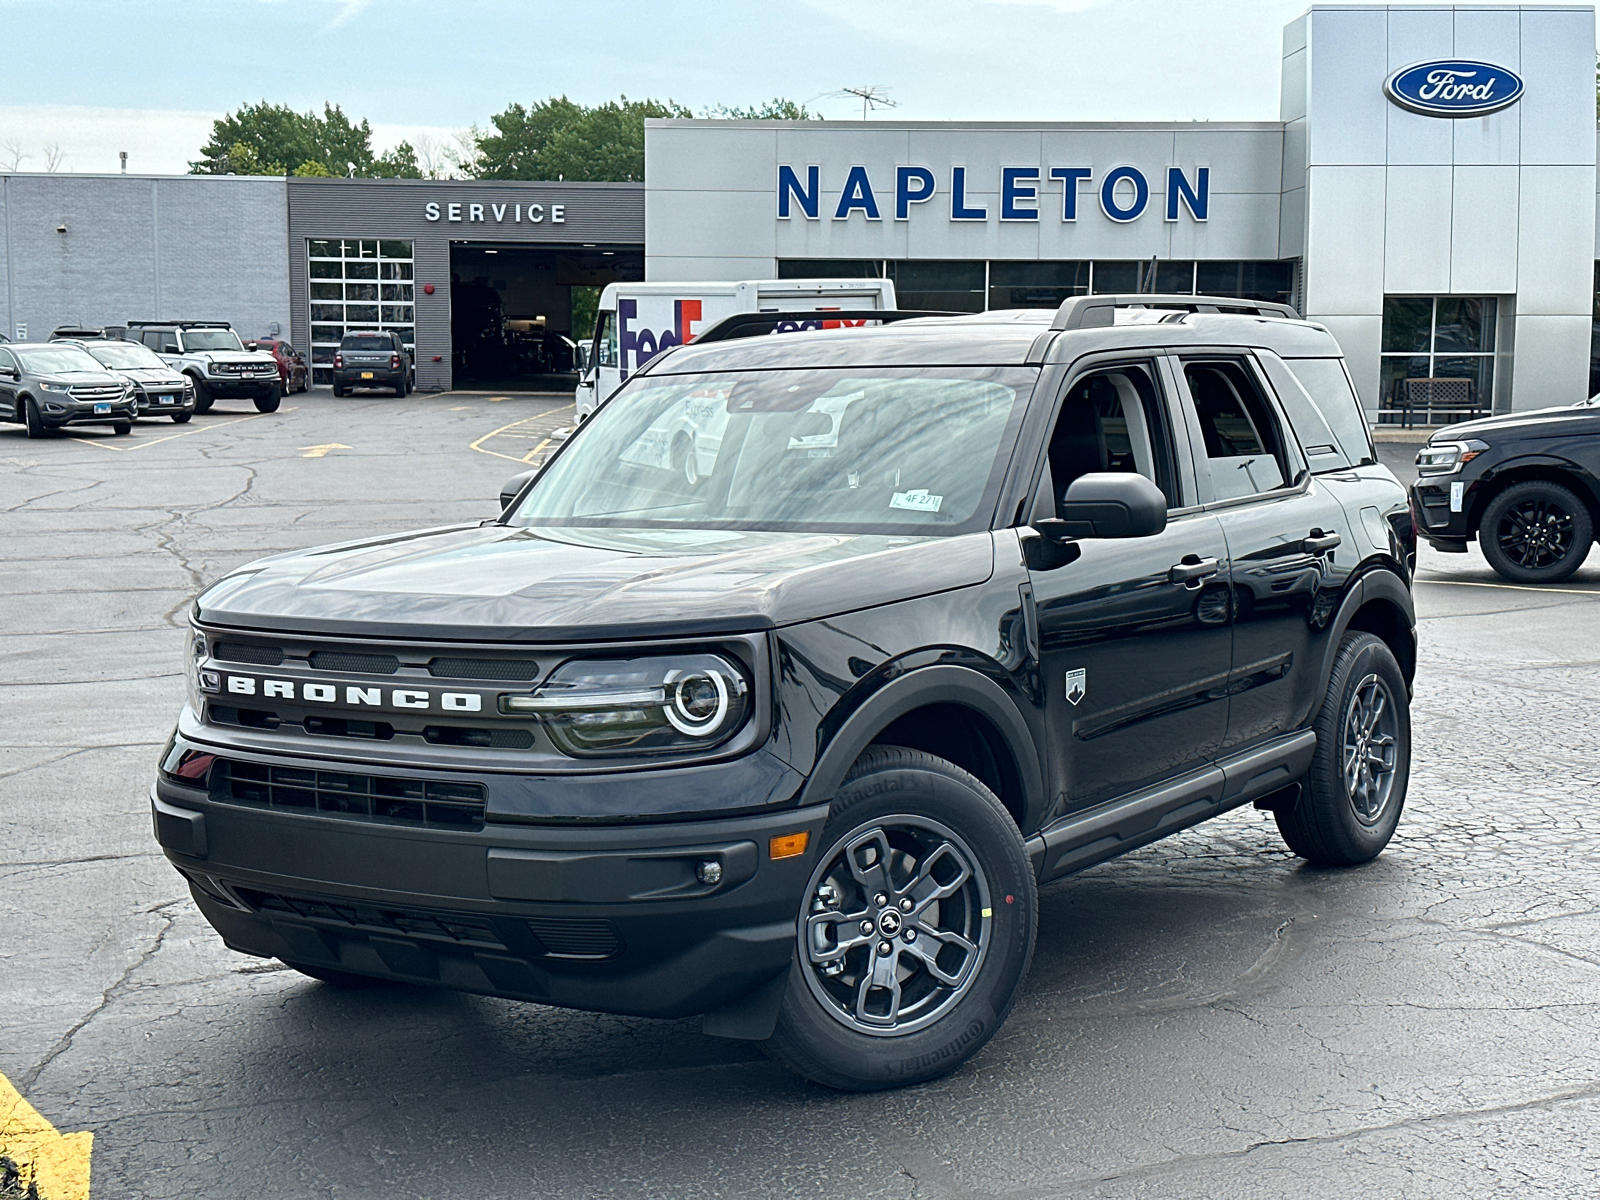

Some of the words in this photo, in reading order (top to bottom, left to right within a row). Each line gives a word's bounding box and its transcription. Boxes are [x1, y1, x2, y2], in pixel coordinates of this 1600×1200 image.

[1418, 69, 1496, 100] Ford
[425, 202, 565, 223] SERVICE
[775, 164, 1211, 224] NAPLETON
[227, 675, 482, 712] BRONCO
[824, 774, 904, 829] ntinental
